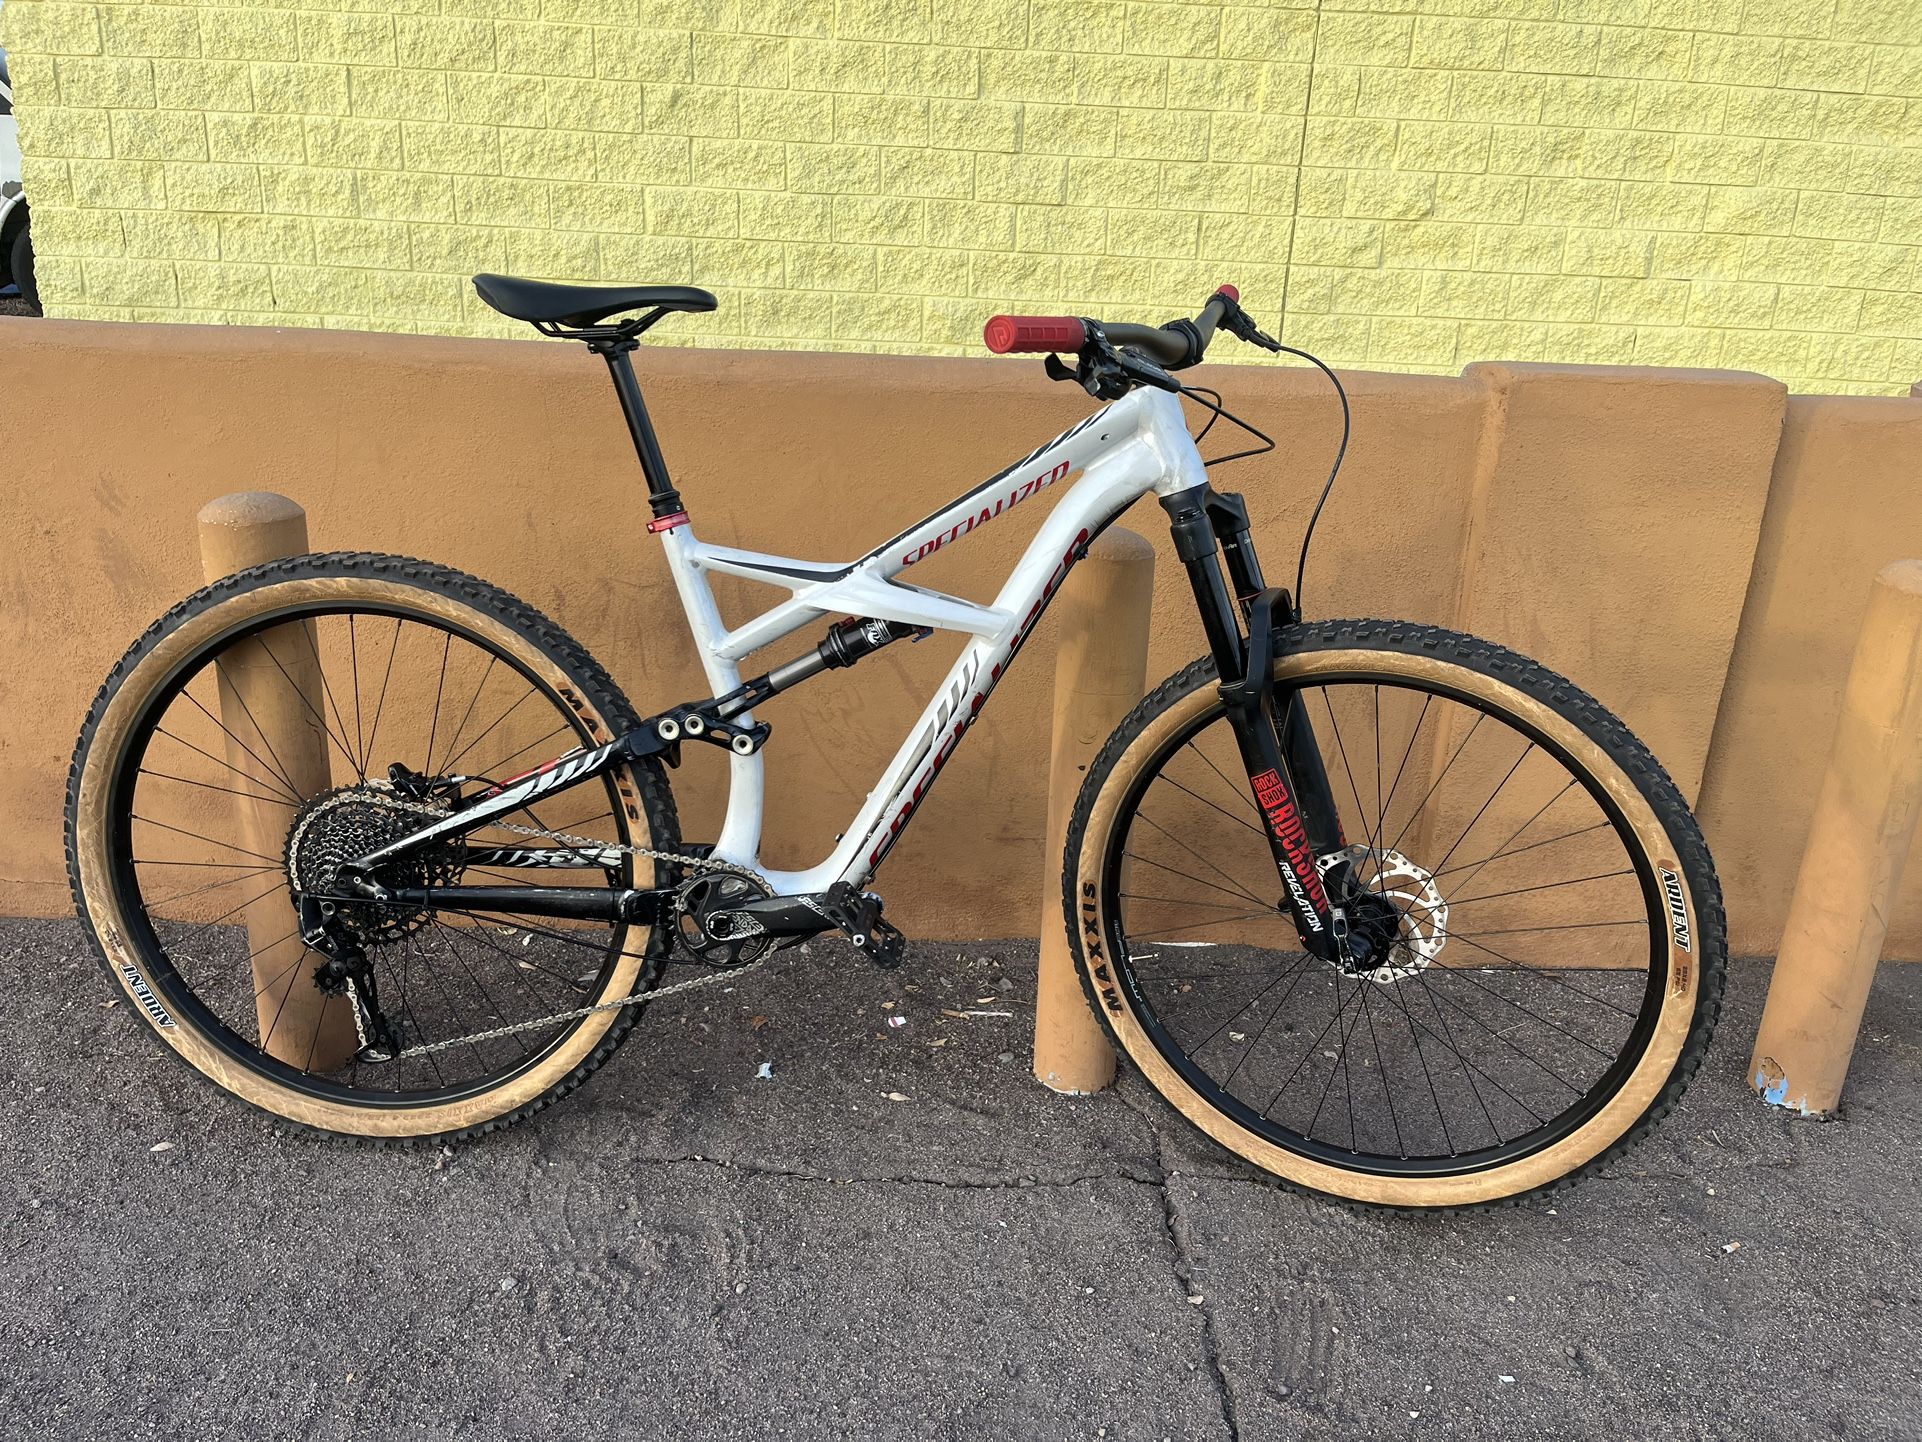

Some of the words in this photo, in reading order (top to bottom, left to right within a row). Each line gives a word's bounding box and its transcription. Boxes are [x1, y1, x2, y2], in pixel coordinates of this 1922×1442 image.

[558, 688, 640, 821] MAXIS
[1254, 772, 1281, 792] ROCK
[1261, 785, 1287, 805] SHOX
[1279, 861, 1324, 932] REVELATION
[1659, 866, 1691, 953] ARDENT
[1082, 881, 1123, 1012] MAXXIS
[120, 964, 177, 1028] ARDENT
